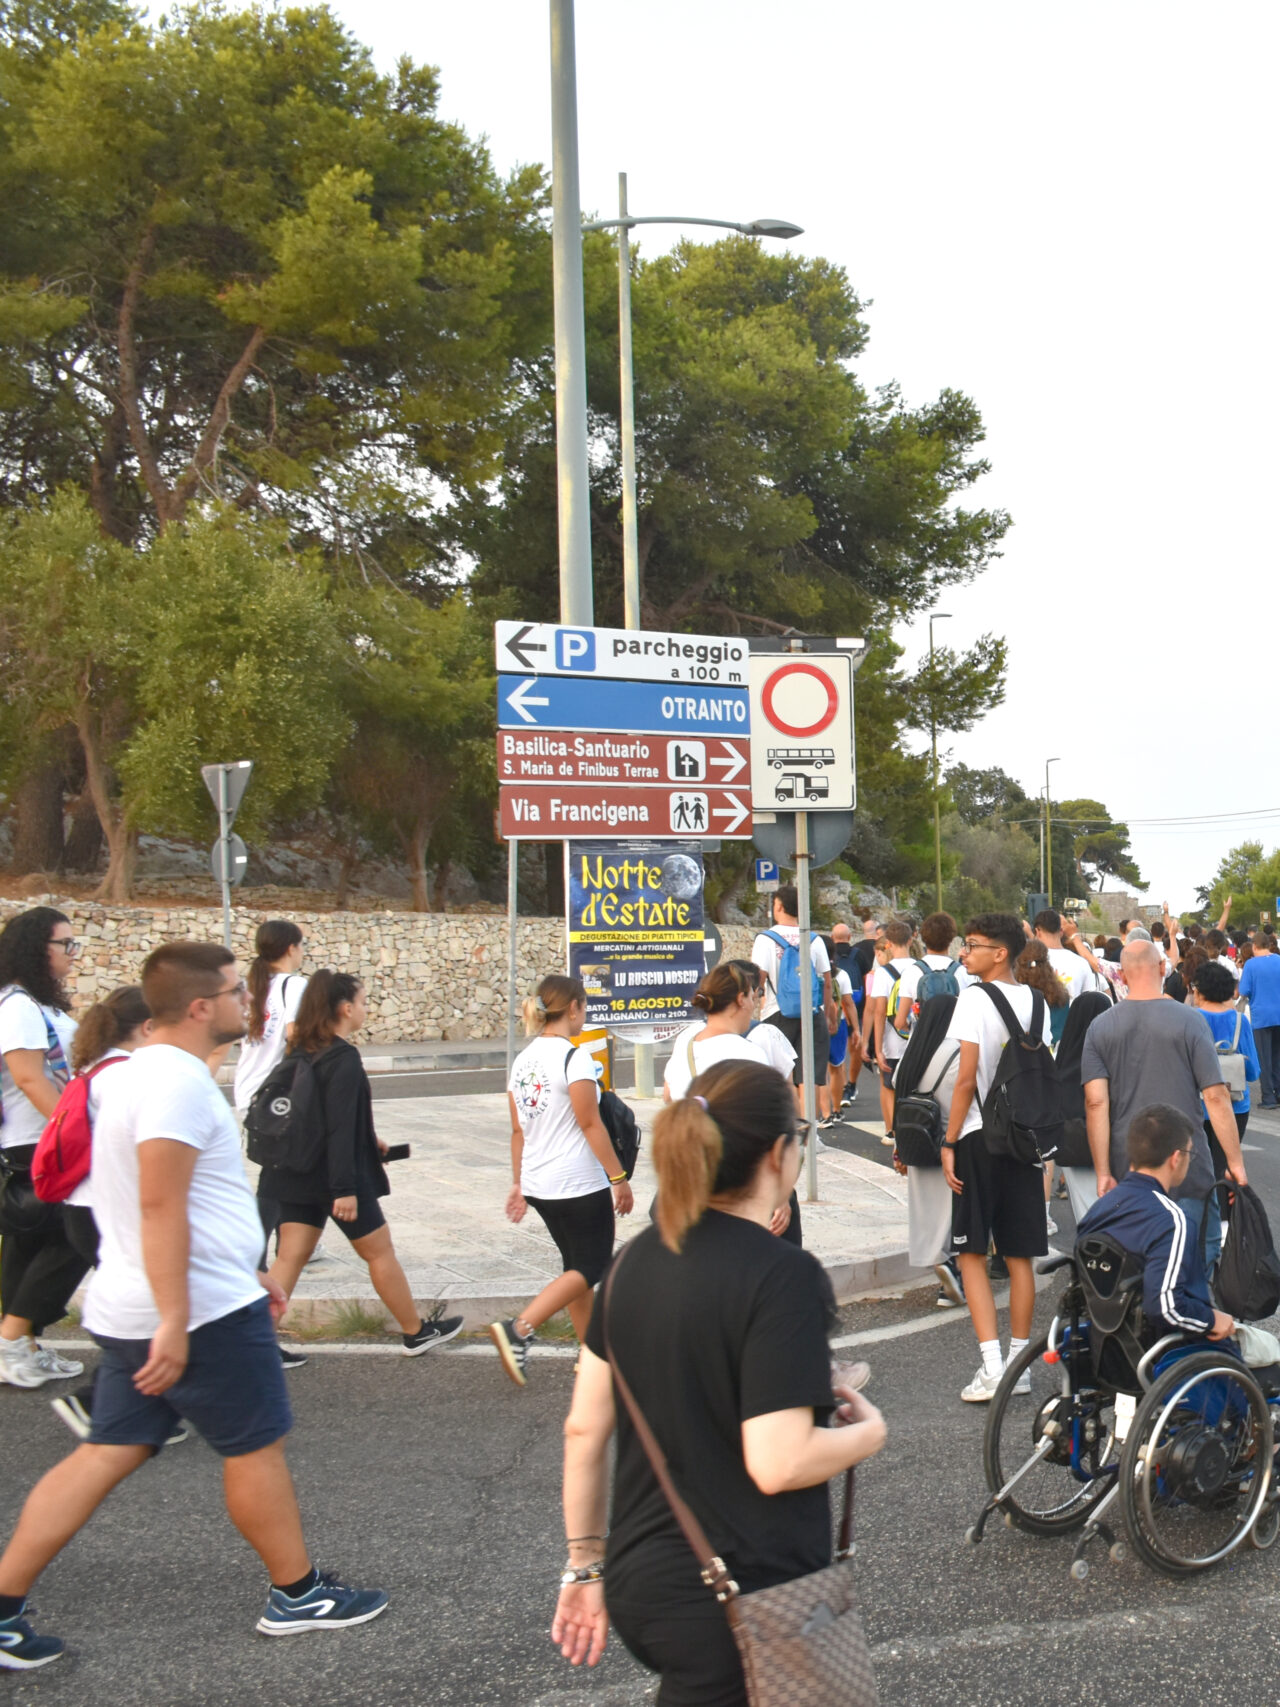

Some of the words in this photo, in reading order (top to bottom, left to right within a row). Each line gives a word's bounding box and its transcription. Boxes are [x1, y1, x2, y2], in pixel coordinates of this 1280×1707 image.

[561, 633, 588, 667] P
[613, 637, 743, 664] parcheggio
[671, 668, 680, 679] a
[688, 666, 720, 681] 100
[729, 671, 742, 683] m
[661, 695, 747, 722] OTRANTO
[503, 735, 650, 760] Basilica-Santuario
[503, 760, 516, 775] S.
[521, 761, 554, 776] Maria
[558, 762, 574, 776] de
[578, 763, 619, 778] Finibus
[624, 766, 660, 779] Terrae
[511, 798, 540, 822] Via
[550, 799, 650, 827] Francigena
[581, 855, 663, 890] Notte
[759, 861, 774, 879] P
[580, 893, 691, 927] d'Estate
[580, 933, 640, 941] DEGUSTAZIONE
[676, 932, 697, 940] TIPICI
[615, 972, 627, 987] LU
[628, 971, 663, 986] RUSCIU
[609, 999, 626, 1012] 16
[627, 997, 683, 1011] AGOSTO
[591, 1011, 650, 1022] SALIGNANO
[654, 1012, 667, 1020] ore
